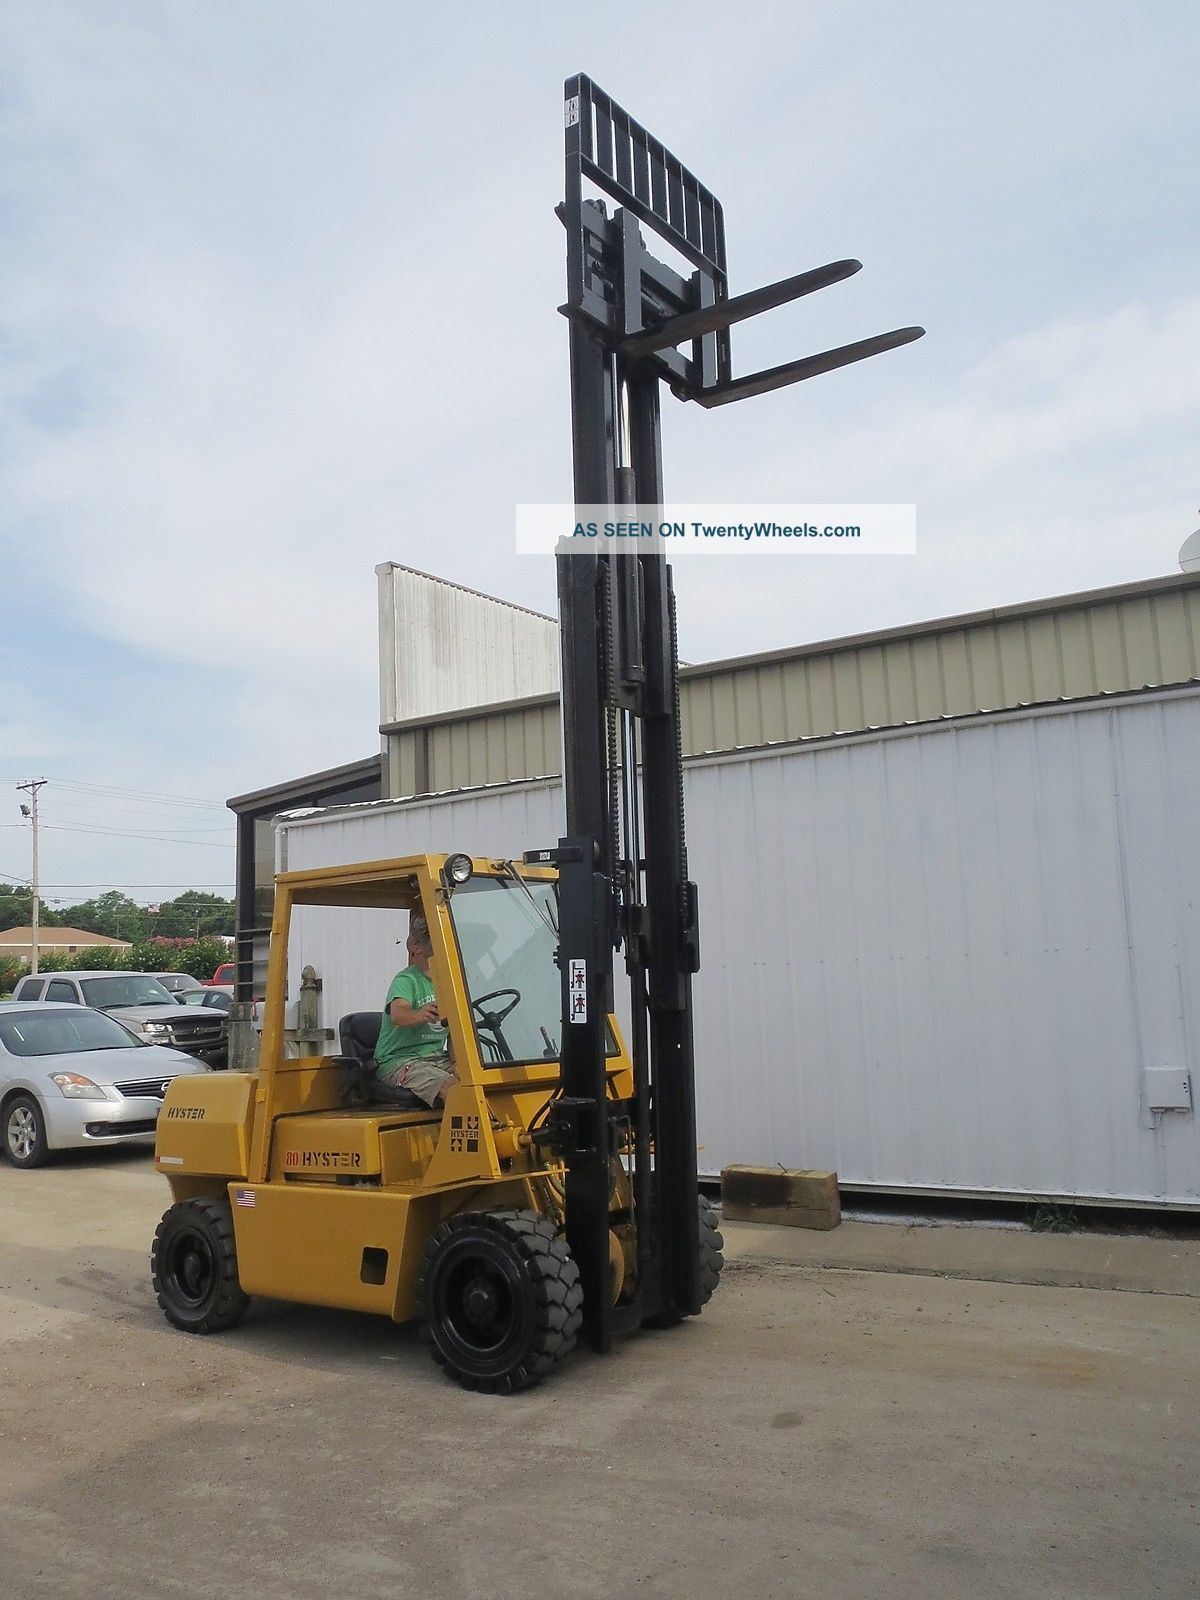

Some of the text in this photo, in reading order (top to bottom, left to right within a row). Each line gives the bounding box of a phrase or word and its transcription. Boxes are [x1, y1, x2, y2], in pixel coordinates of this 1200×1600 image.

[167, 1107, 206, 1119] HYSTER
[450, 1130, 479, 1139] HYSTER
[286, 1151, 361, 1168] 80 HYSTER
